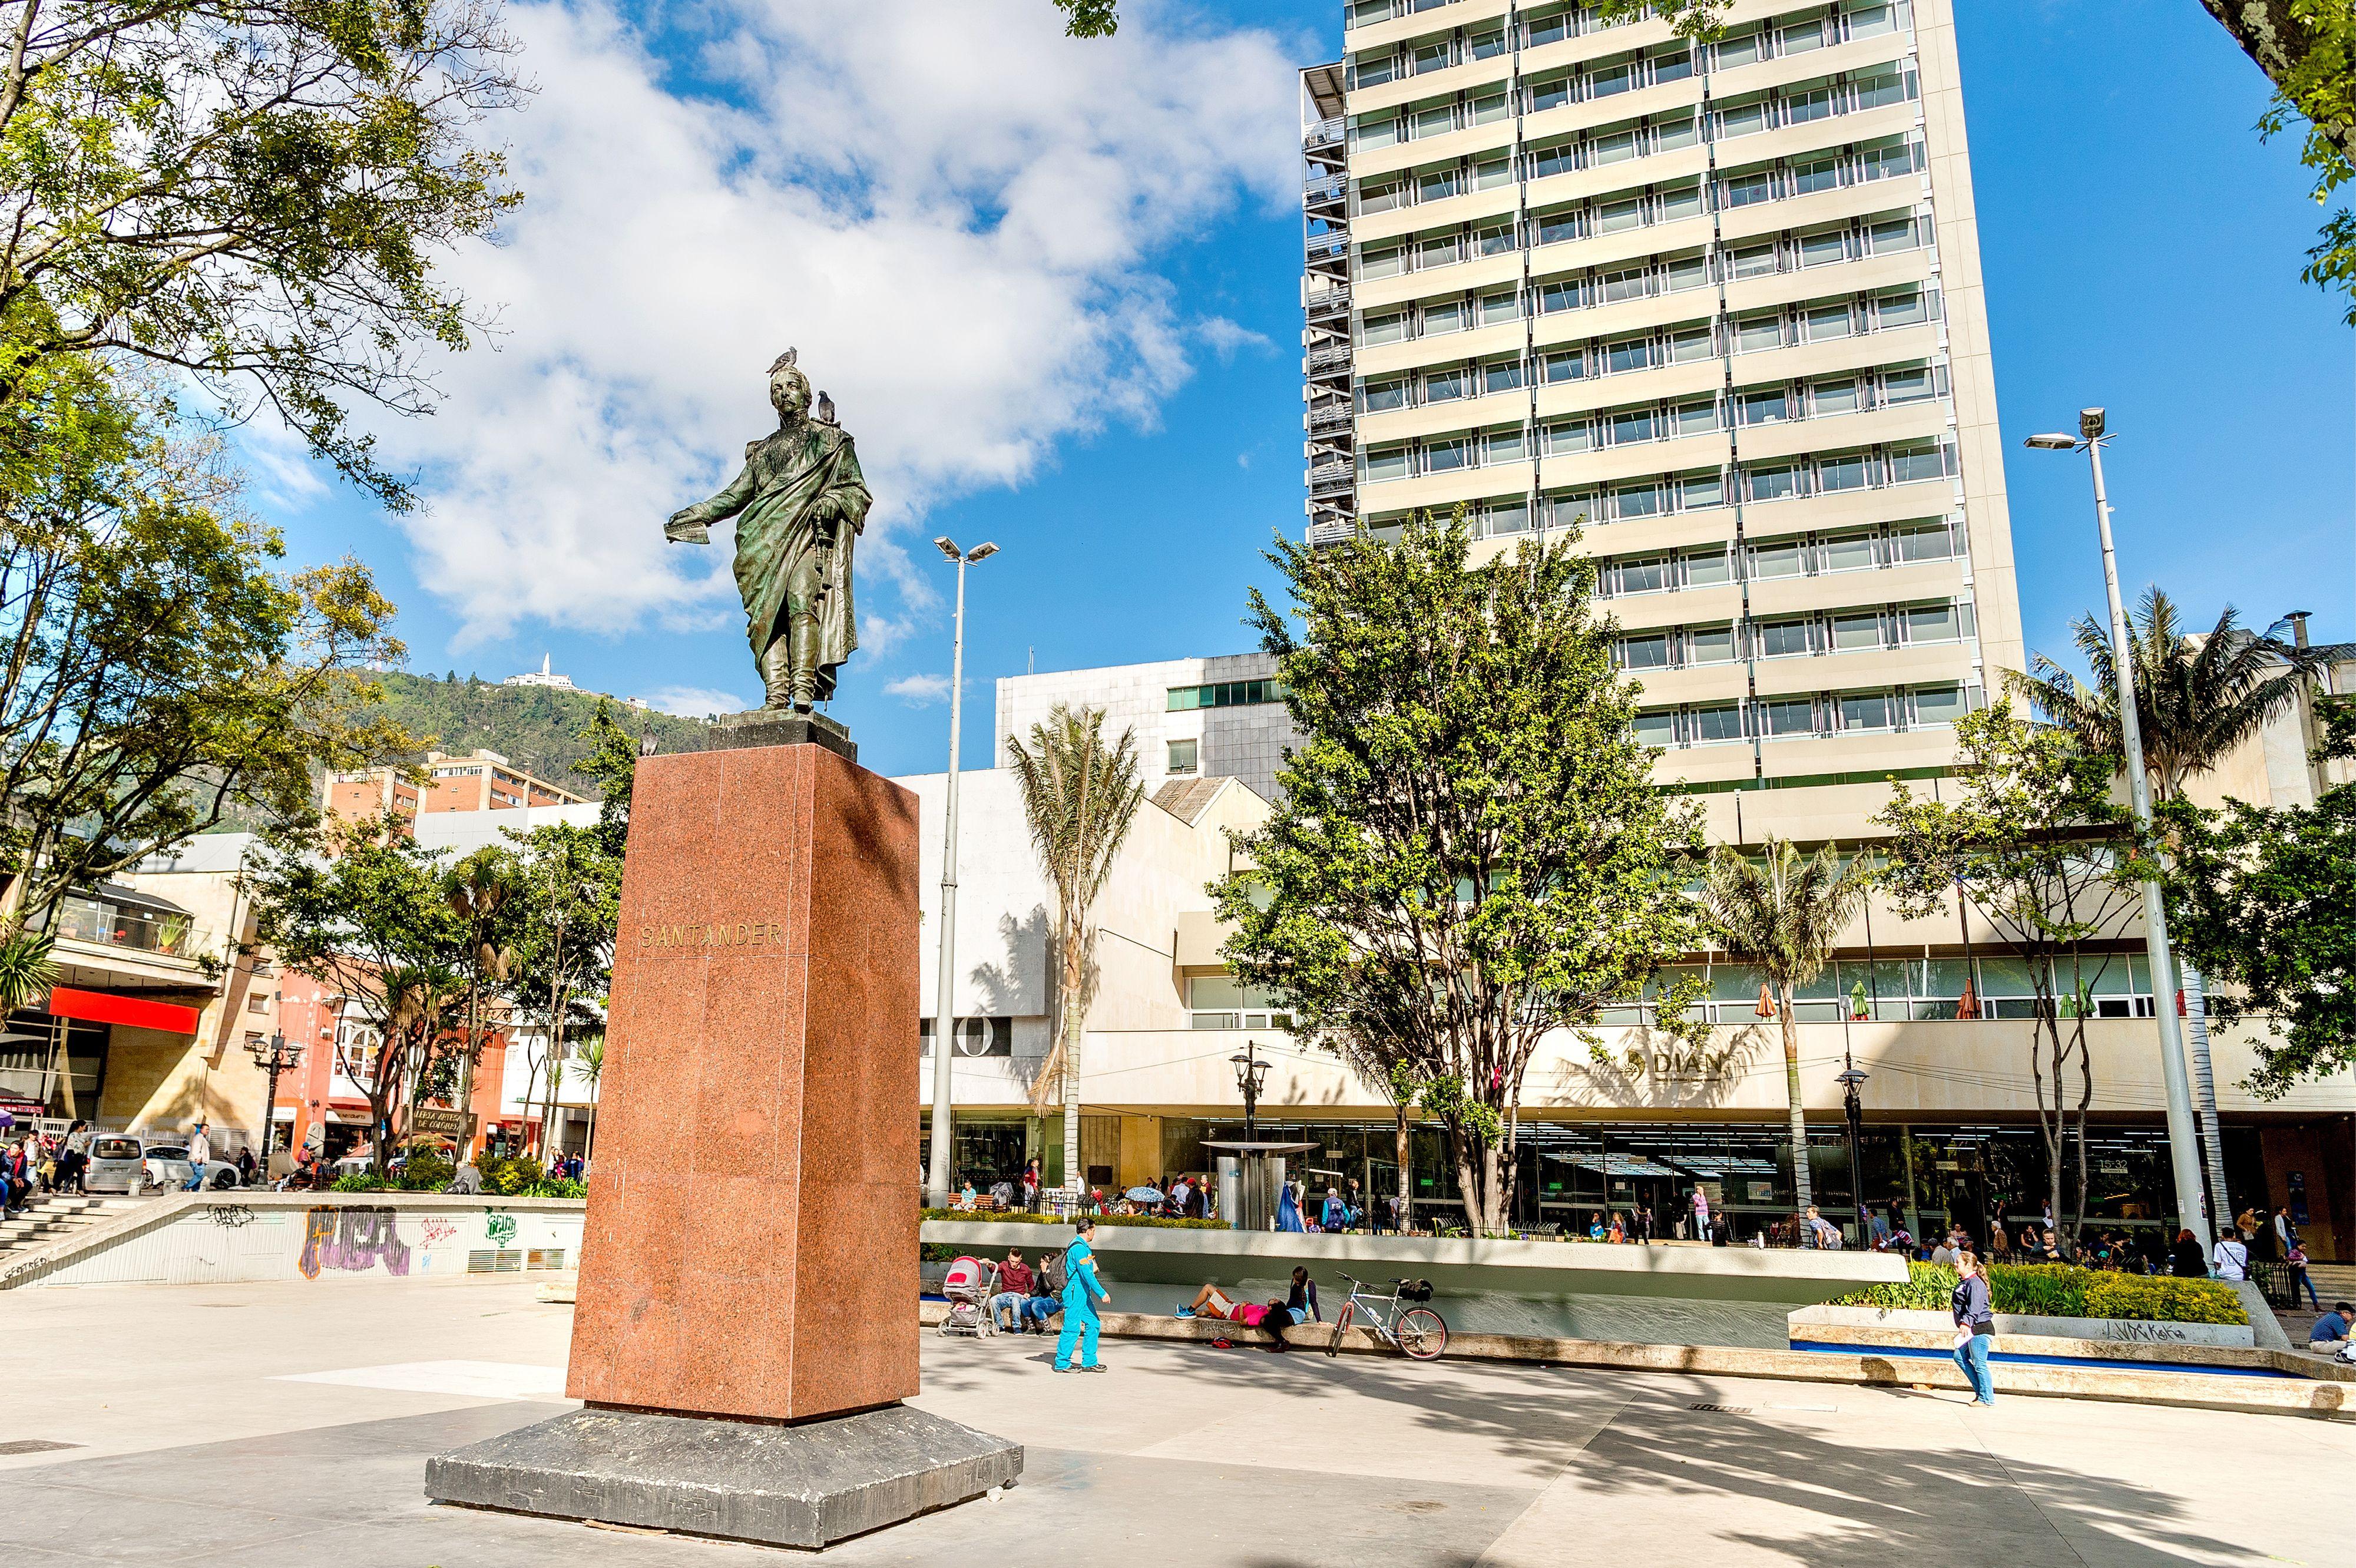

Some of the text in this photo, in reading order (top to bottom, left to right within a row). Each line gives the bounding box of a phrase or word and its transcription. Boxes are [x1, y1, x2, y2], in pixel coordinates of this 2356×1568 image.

[641, 922, 782, 948] SANTANDER
[1654, 1053, 1722, 1073] DIAN
[2099, 1159, 2127, 1169] 15-32
